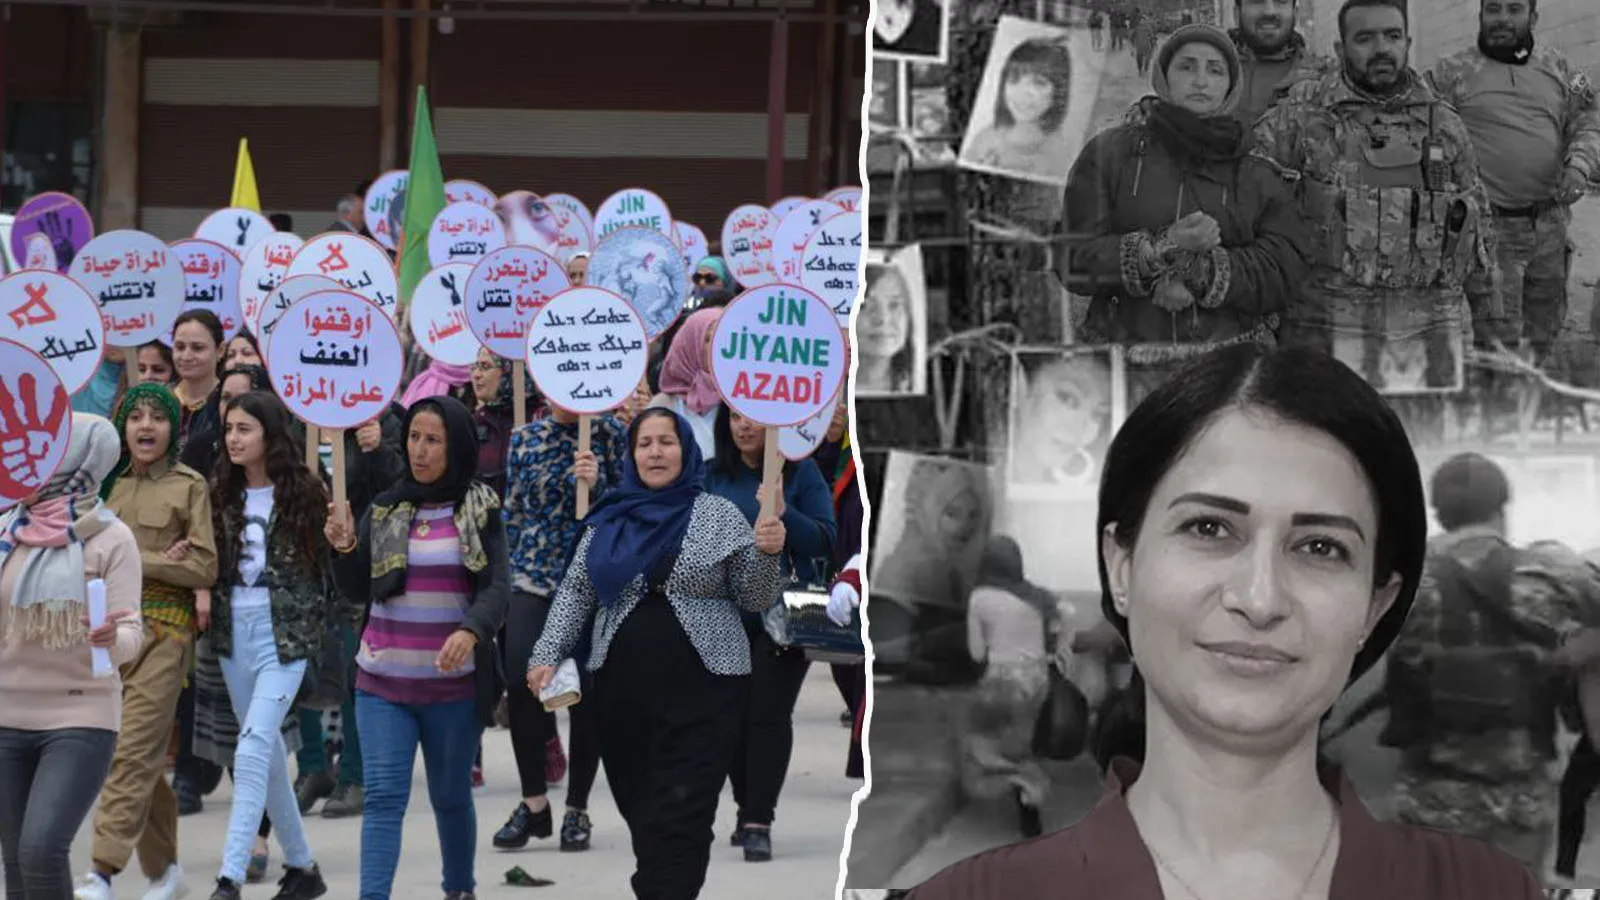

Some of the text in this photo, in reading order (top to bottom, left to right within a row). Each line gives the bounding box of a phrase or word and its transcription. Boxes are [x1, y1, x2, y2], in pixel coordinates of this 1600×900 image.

[82, 248, 166, 277] المرأة حياة
[477, 288, 512, 313] تقتل
[758, 290, 808, 327] JİN
[102, 312, 155, 337] الحياة
[303, 305, 372, 339] أوقفوا
[300, 341, 368, 367] العنف
[720, 325, 830, 367] JİYANE
[283, 371, 384, 408] على المرأة
[731, 371, 823, 405] AZADÎ
